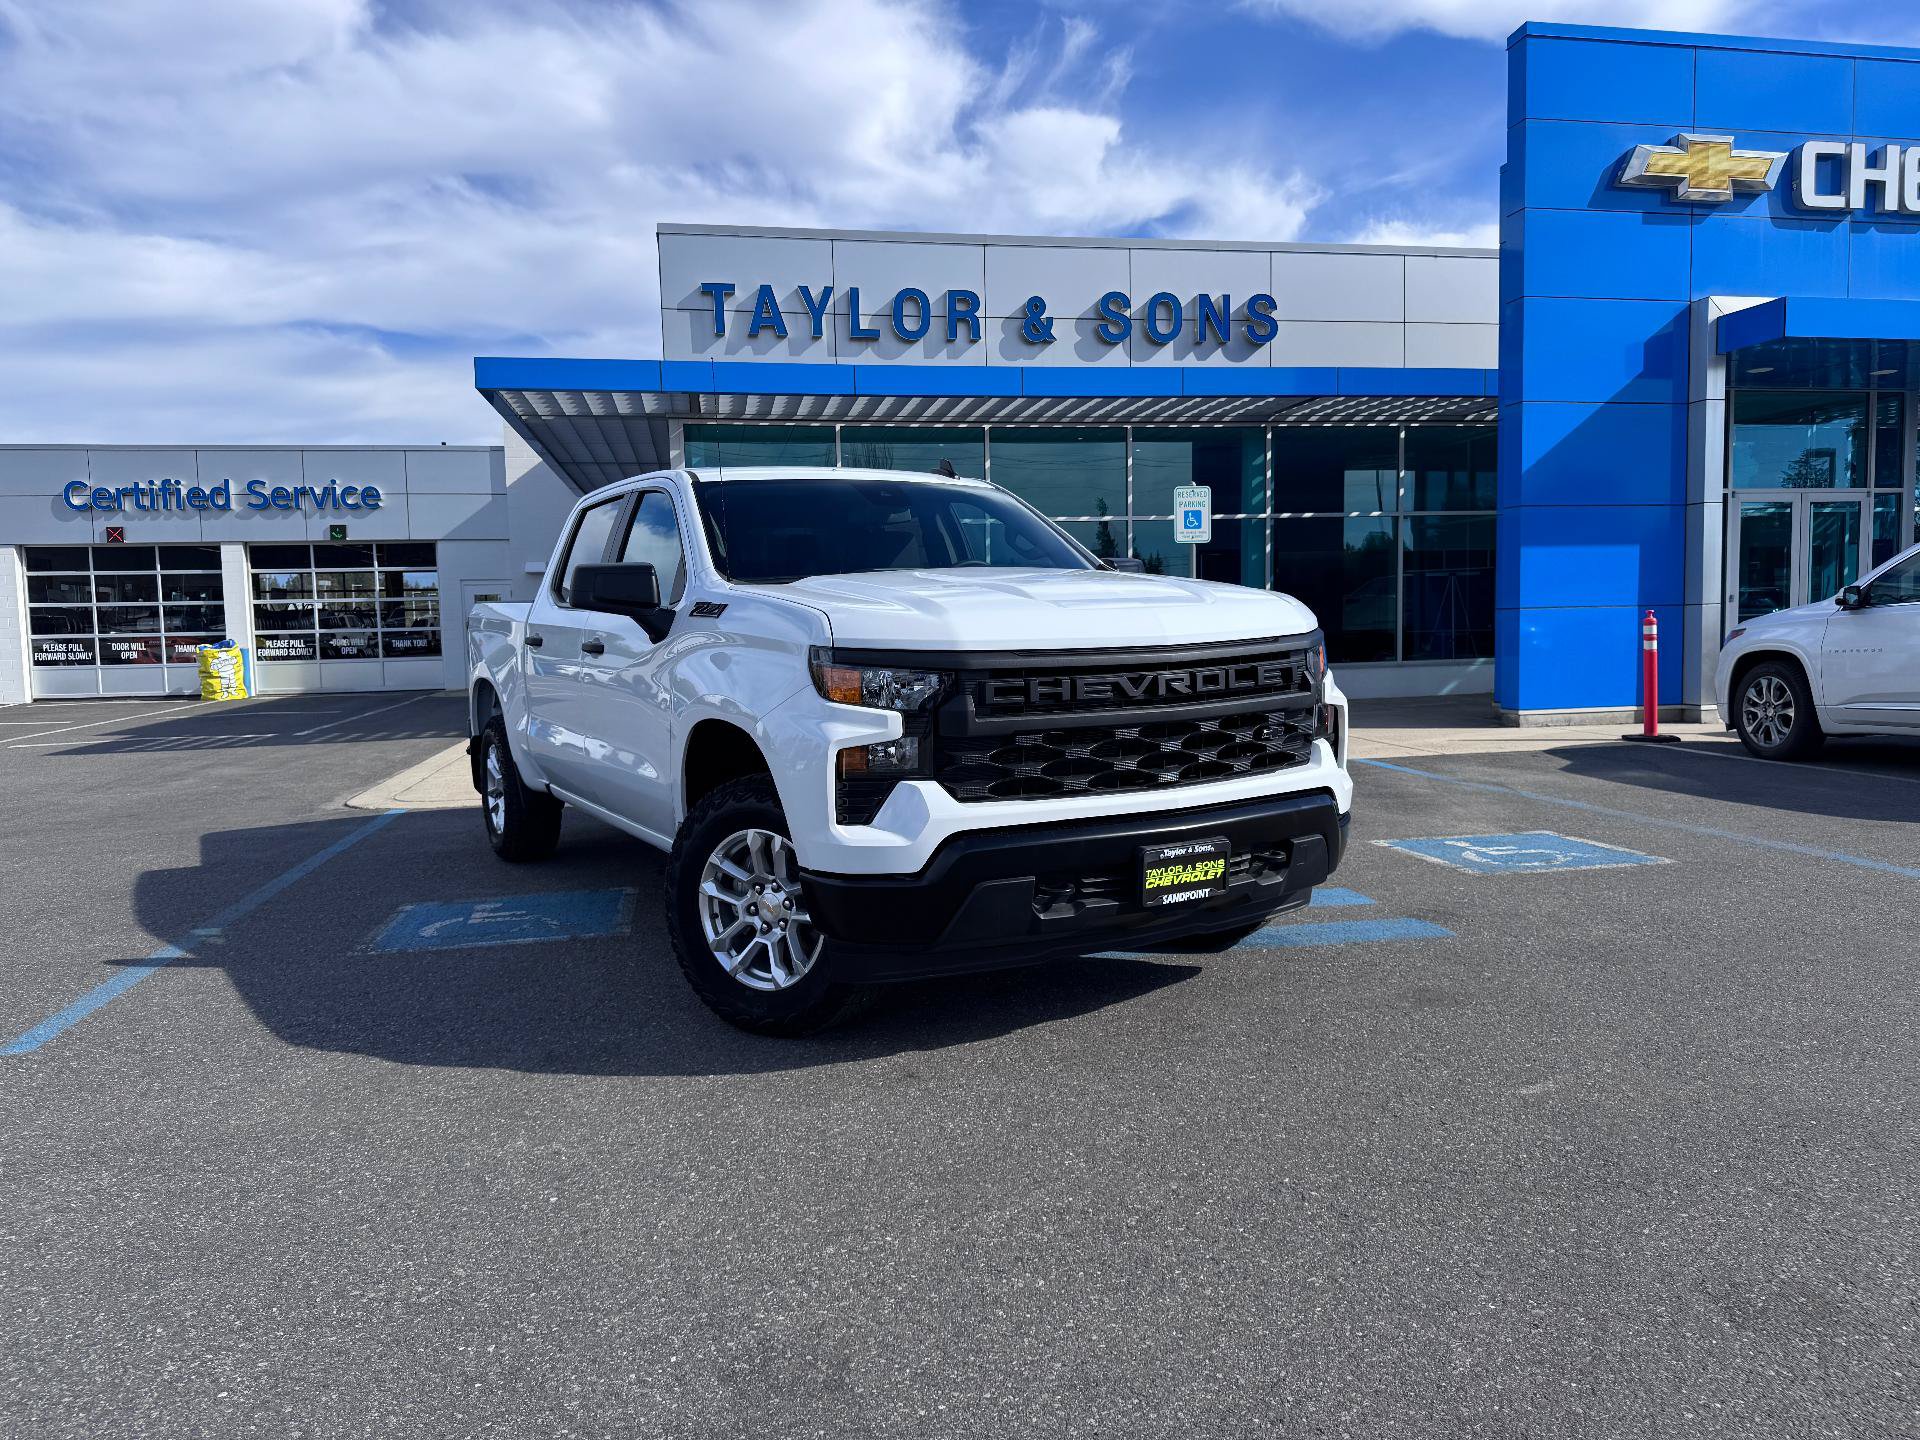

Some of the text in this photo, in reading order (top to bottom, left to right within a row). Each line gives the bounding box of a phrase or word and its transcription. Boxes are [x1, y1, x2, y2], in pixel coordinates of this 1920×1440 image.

[700, 282, 1279, 346] TAYLOR & SONS
[63, 479, 382, 511] Certified Service
[1177, 490, 1207, 498] RESERVED
[1178, 500, 1206, 508] PARKING
[112, 643, 130, 651] DOOR
[131, 642, 147, 650] WILL
[265, 639, 305, 648] PLEASE PULL
[332, 638, 367, 646] DOOR WILL
[392, 639, 428, 647] THANK YOU!
[43, 643, 84, 652] PLEASE PULL
[174, 645, 196, 653] THANK
[257, 647, 313, 657] FORWARD SLOWLY
[341, 646, 357, 655] OPEN
[34, 652, 92, 661] FORWARD SLOWLY
[121, 651, 138, 660] OPEN
[985, 662, 1303, 704] CHEVROLET
[1163, 848, 1186, 858] Taylor
[1194, 844, 1211, 853] Sons
[1145, 858, 1225, 878] TAYLOR & SONS
[1145, 868, 1226, 889] CHEVROLET
[1162, 888, 1211, 905] SANDPOINT
